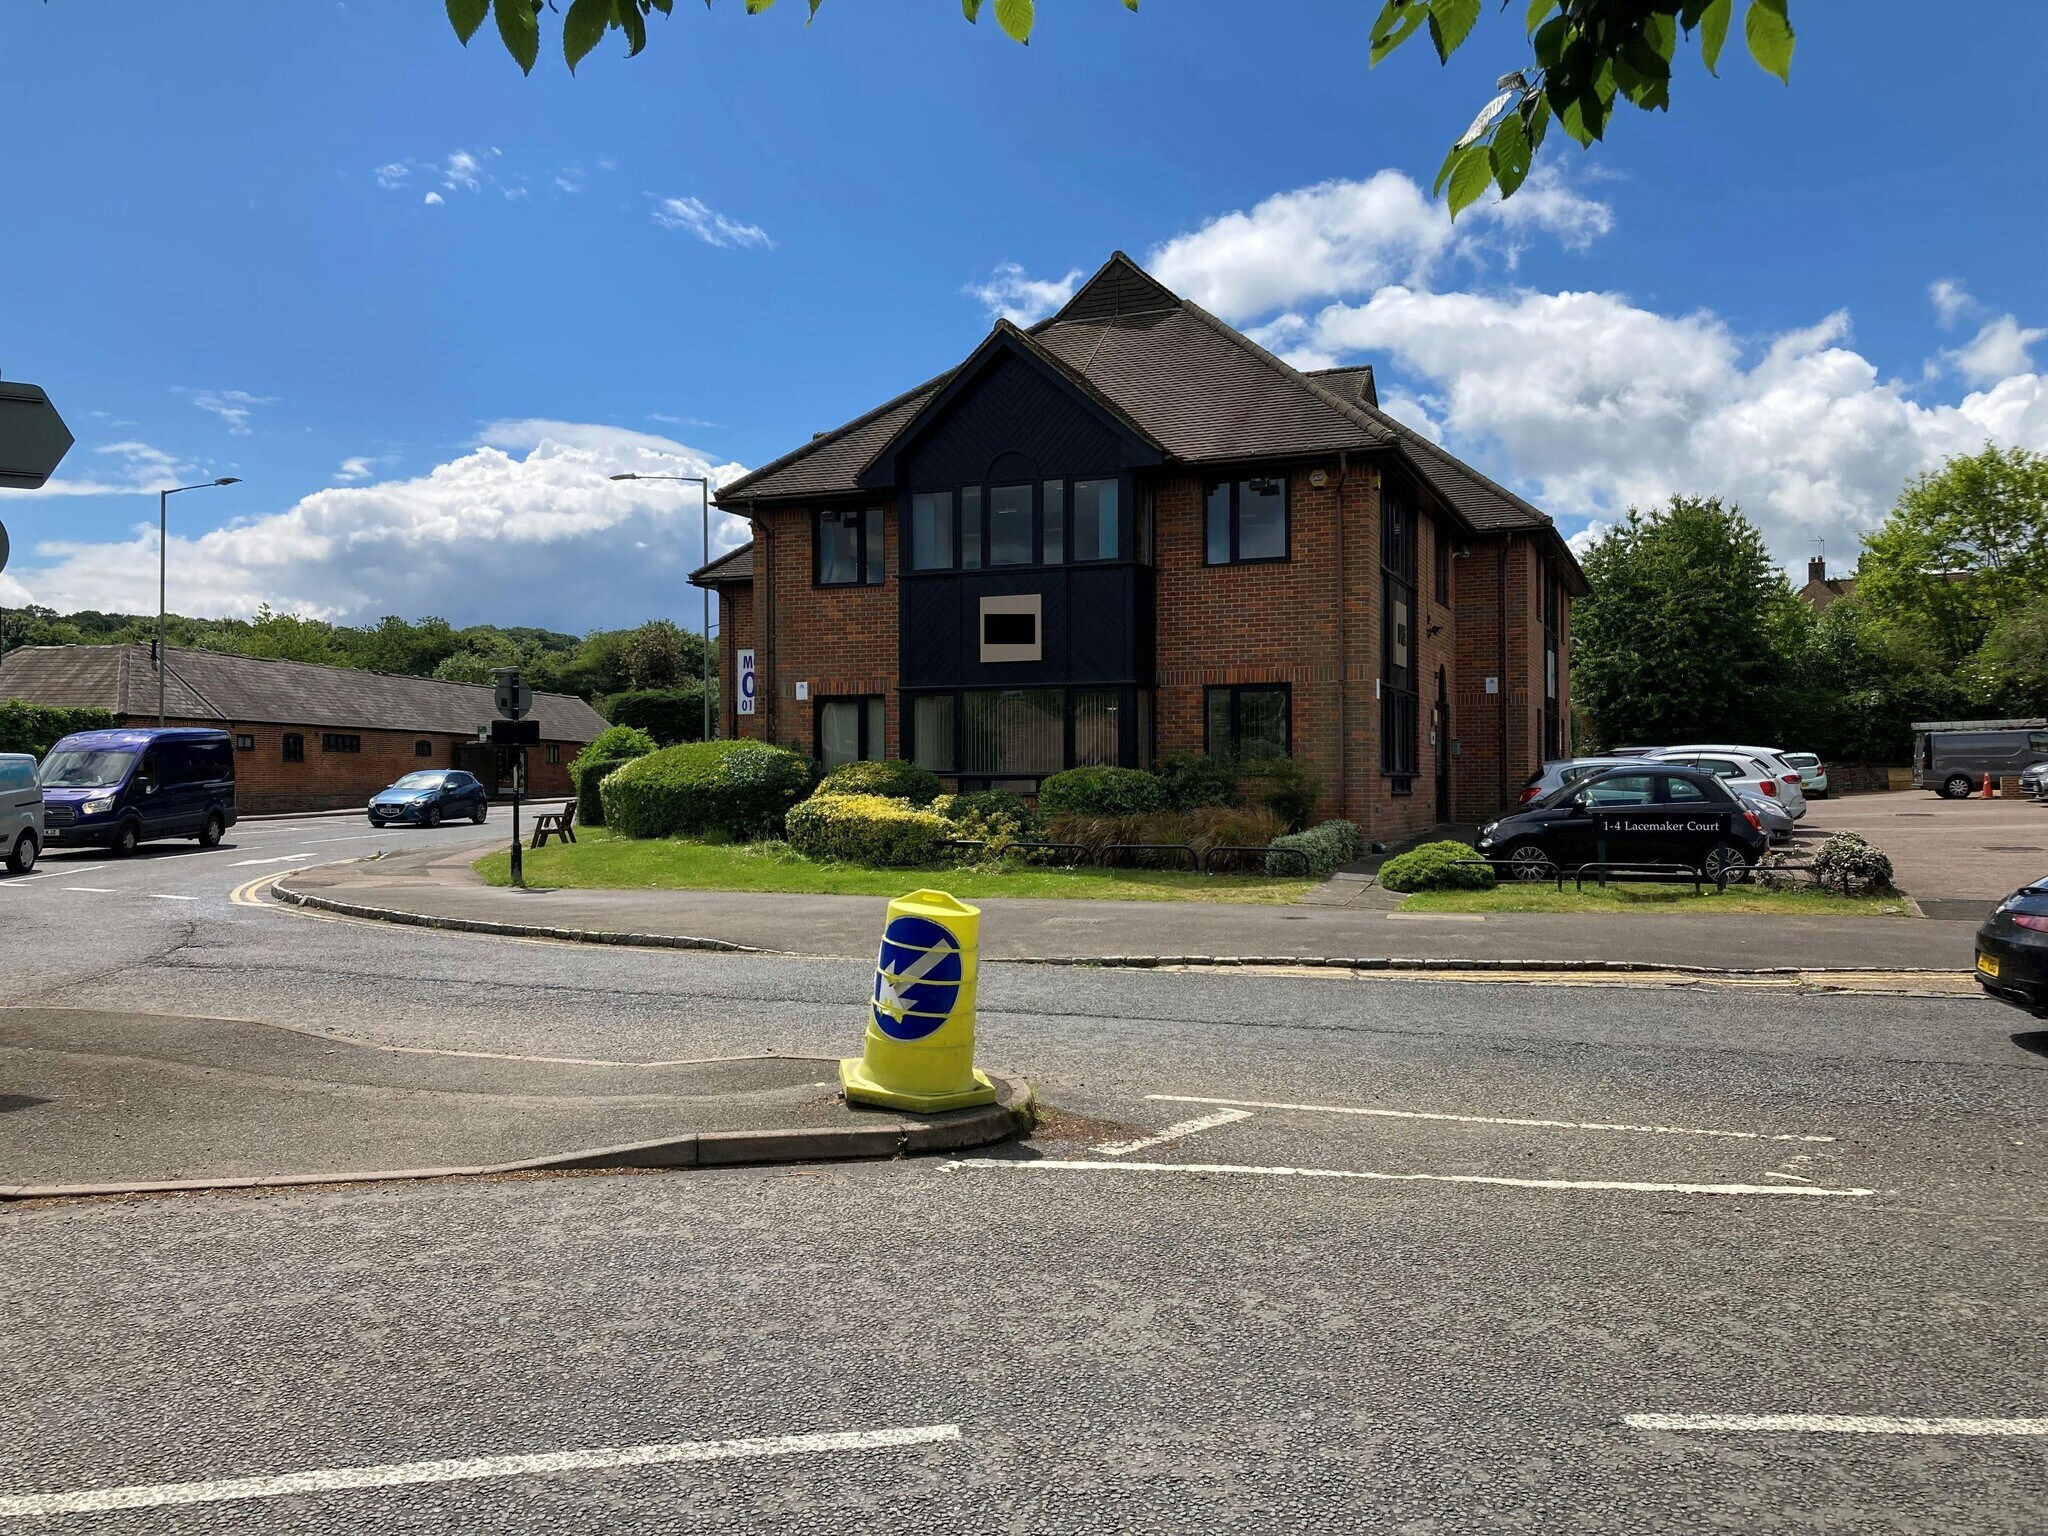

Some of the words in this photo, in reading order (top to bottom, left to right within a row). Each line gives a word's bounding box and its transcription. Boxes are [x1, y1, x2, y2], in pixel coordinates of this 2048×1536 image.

[1603, 821, 1621, 831] 1-4
[1624, 821, 1684, 831] Lacemaker
[1686, 821, 1719, 831] Court
